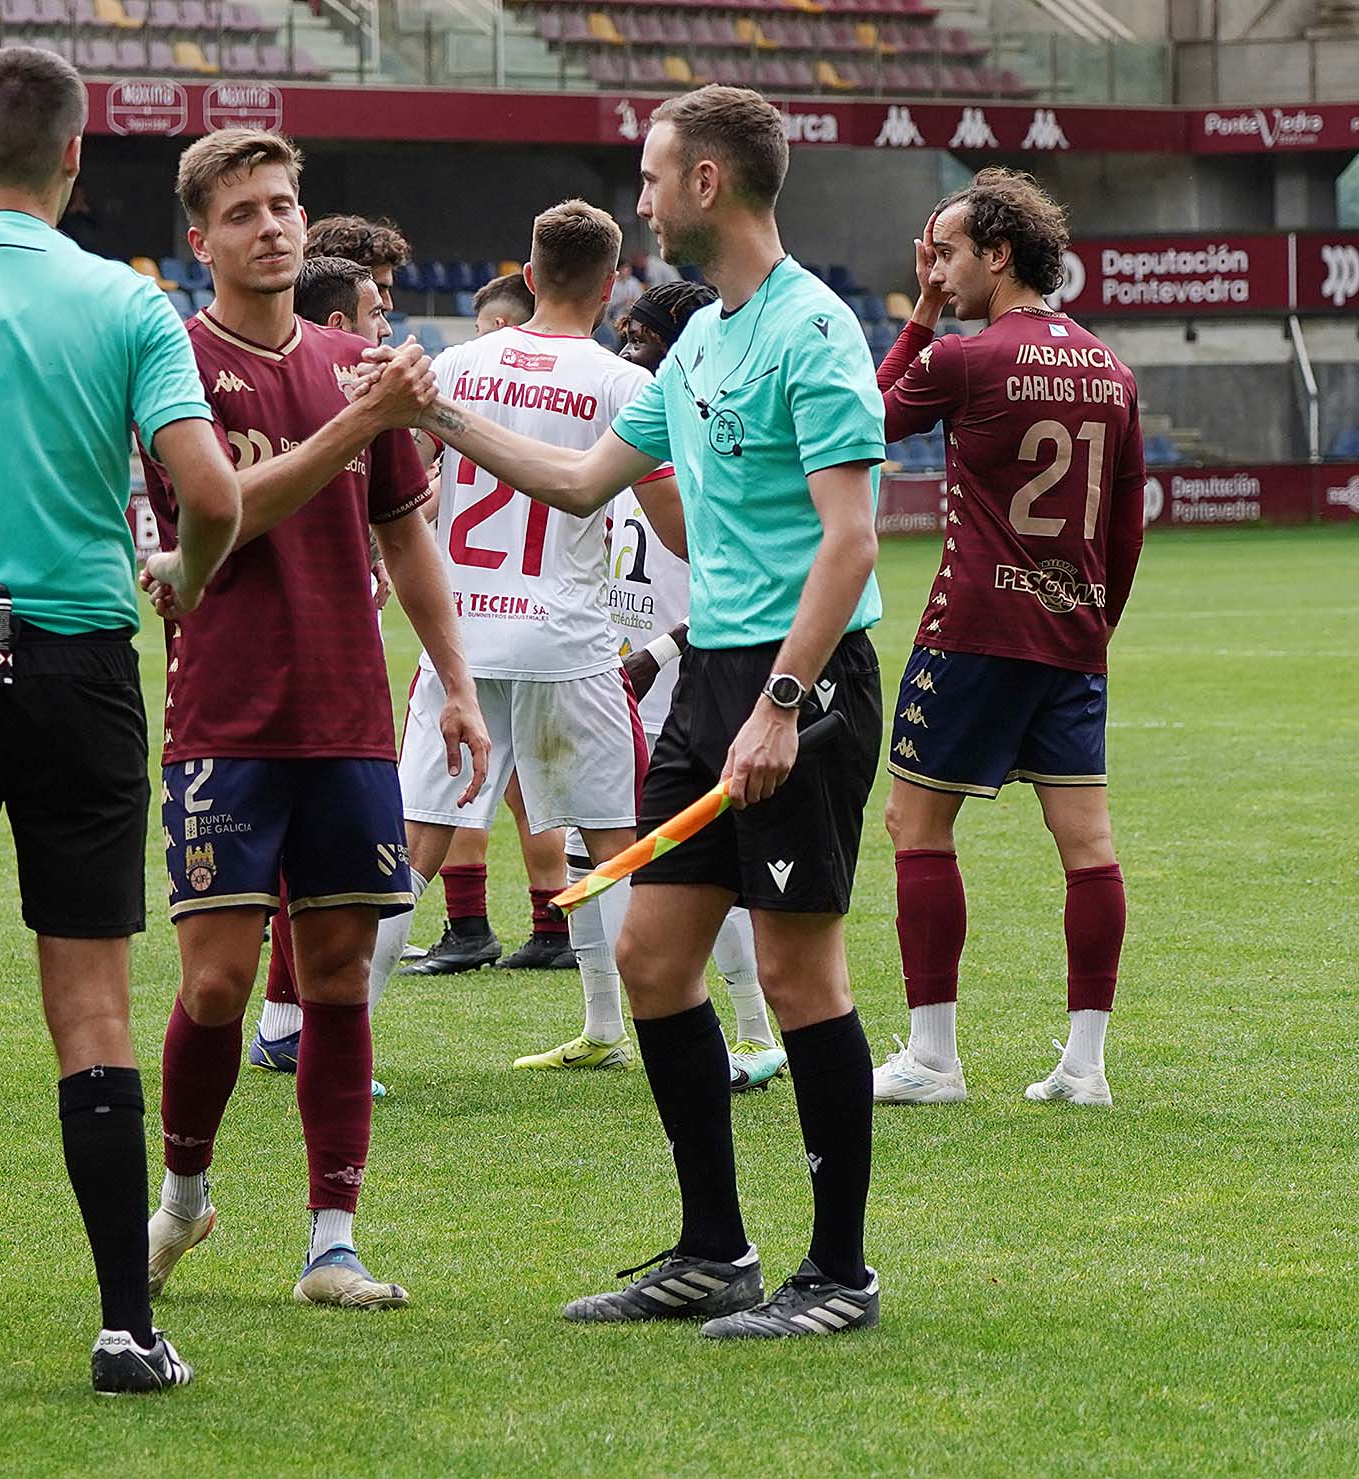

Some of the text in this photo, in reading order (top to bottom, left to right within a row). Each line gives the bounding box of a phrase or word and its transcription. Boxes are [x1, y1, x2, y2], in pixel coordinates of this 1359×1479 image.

[1102, 243, 1249, 282] Deputación
[1102, 274, 1250, 304] Pontevedra
[452, 370, 598, 421] ÁLEX MORENO
[1006, 376, 1076, 403] CARLOS
[1009, 419, 1106, 541] 21
[448, 455, 551, 578] 21
[470, 593, 529, 614] TECEIN
[608, 585, 655, 615] ÁVILA
[610, 611, 653, 631] uténtica
[184, 758, 214, 814] 2
[199, 814, 233, 826] XUNTA
[199, 822, 252, 835] DE GALICIA
